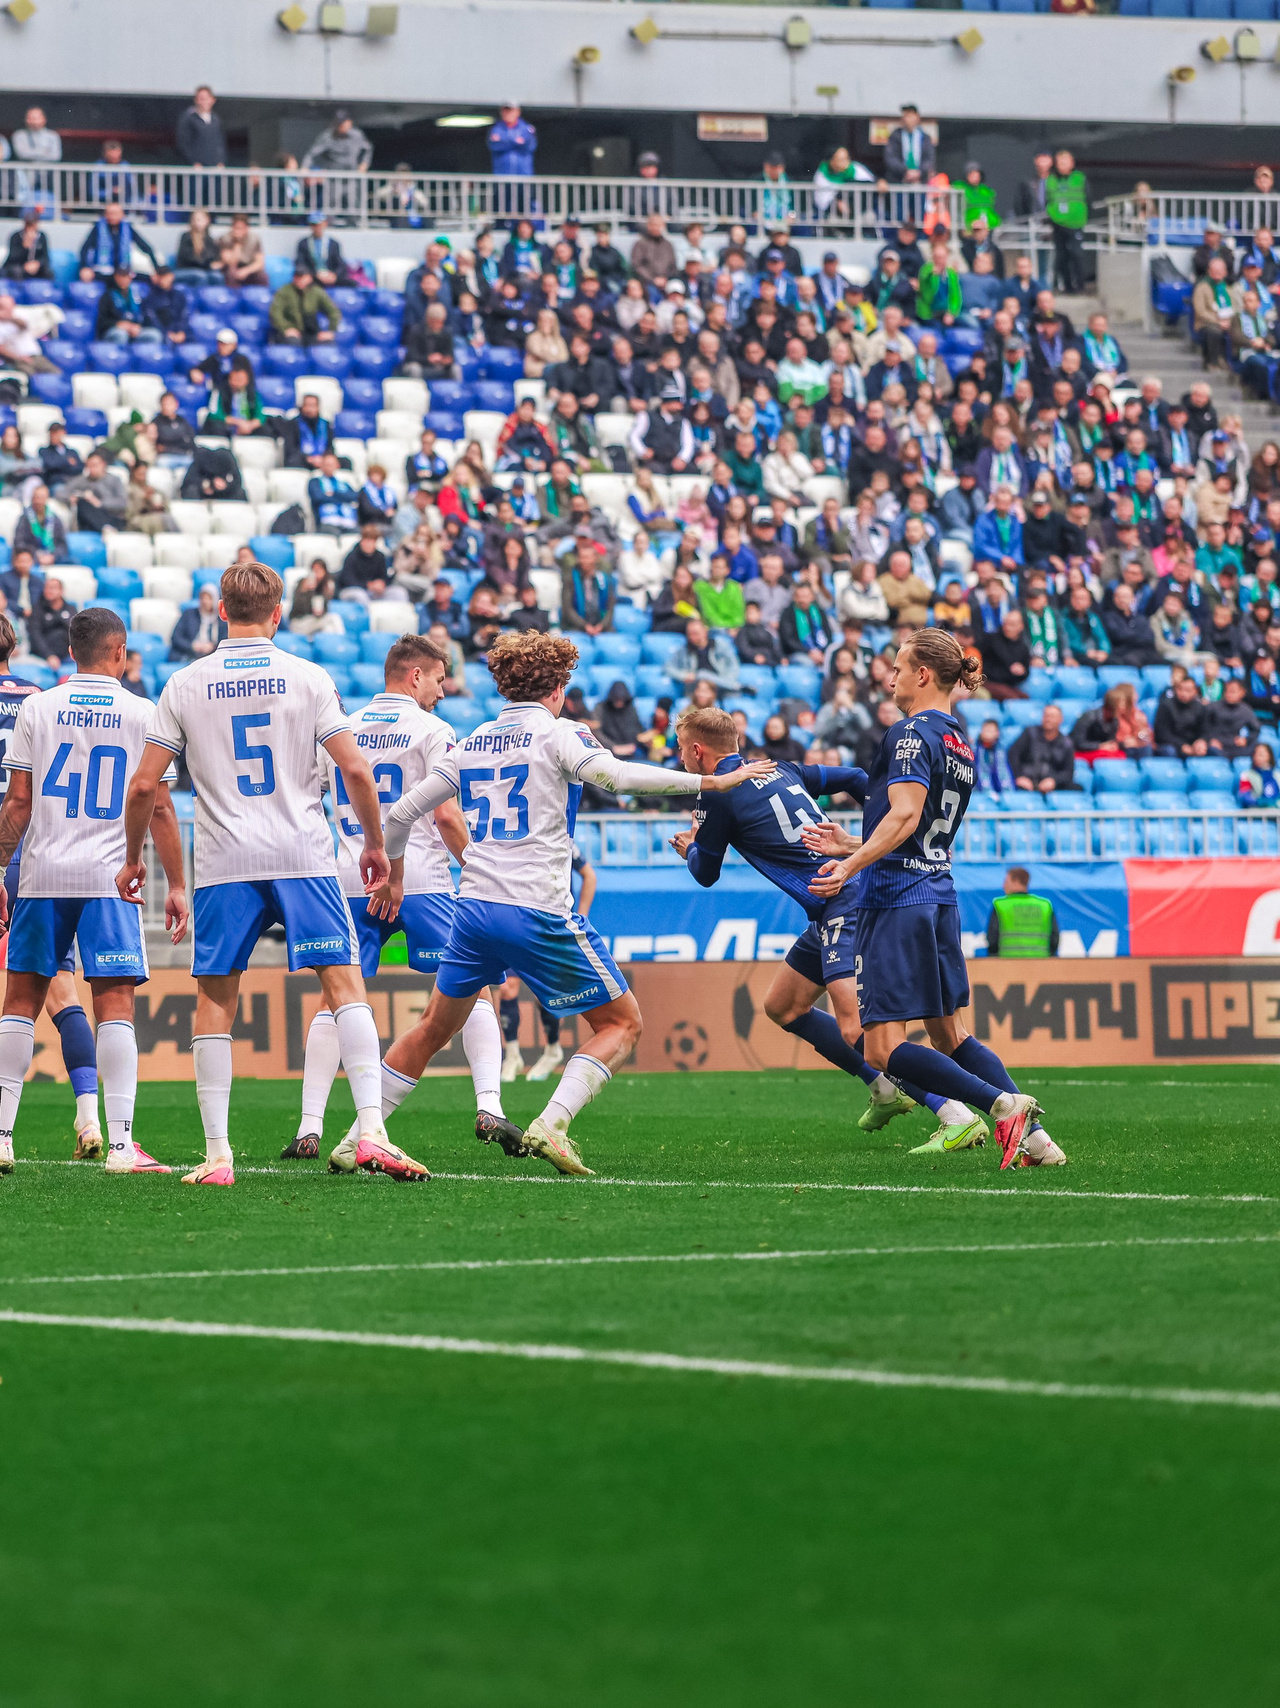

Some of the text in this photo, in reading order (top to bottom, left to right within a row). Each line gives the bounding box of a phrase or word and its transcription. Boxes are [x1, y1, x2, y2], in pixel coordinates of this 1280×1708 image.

[224, 659, 269, 667] БЕТСИТИ
[207, 678, 286, 700] ГАБАРАЕВ
[70, 696, 113, 704] БЕТСИТИ
[57, 709, 122, 729] КЛЕЙТОН
[354, 733, 411, 749] ФУЛЛИН
[464, 731, 533, 754] БАРДАЧЁВ
[895, 738, 923, 750] FON
[231, 712, 275, 797] 5
[895, 748, 921, 760] BET
[41, 742, 128, 820] 40
[459, 764, 530, 843] 53
[695, 810, 707, 820] ON
[923, 789, 961, 861] 2
[293, 939, 343, 952] БЕТСИТИ
[97, 954, 139, 963] БЕТСИТИ
[418, 951, 444, 959] БЕТС
[548, 986, 599, 1007] БЕТСИТИ
[974, 983, 1138, 1040] МАТЧ
